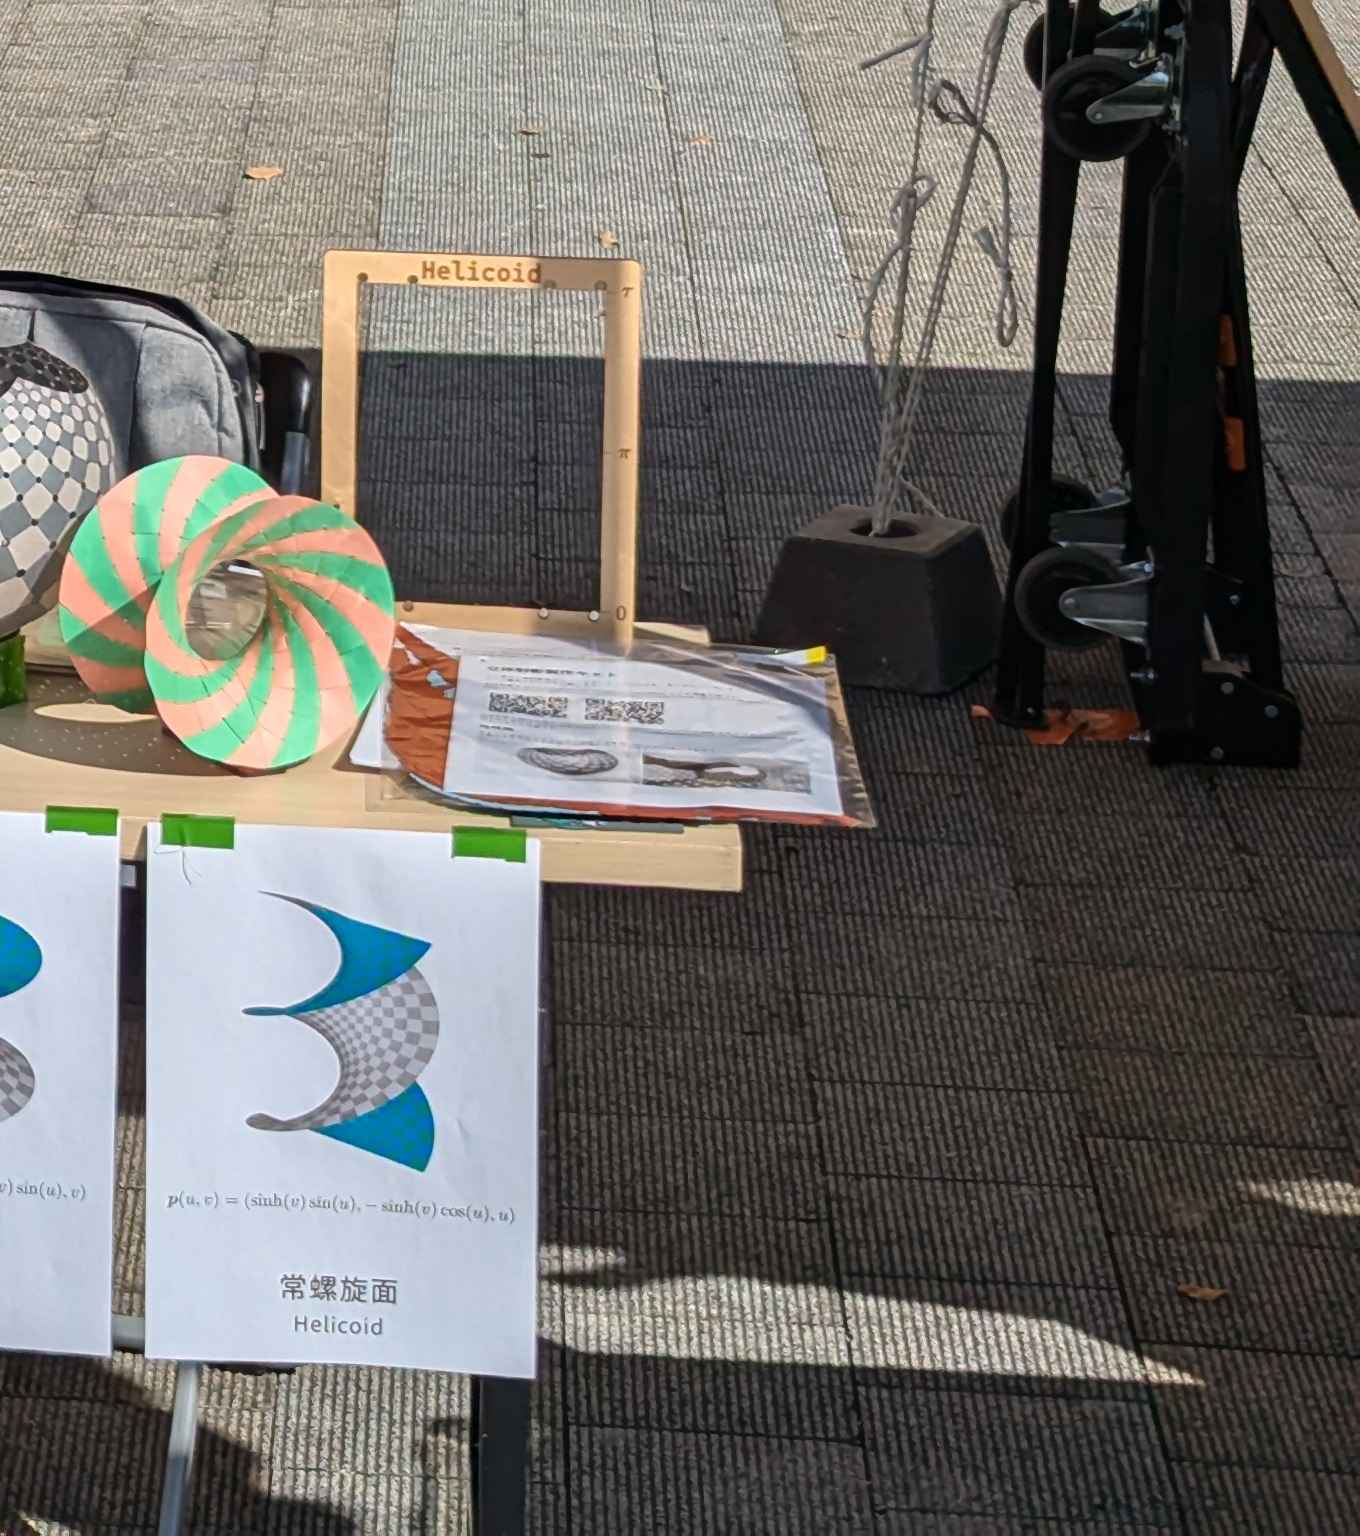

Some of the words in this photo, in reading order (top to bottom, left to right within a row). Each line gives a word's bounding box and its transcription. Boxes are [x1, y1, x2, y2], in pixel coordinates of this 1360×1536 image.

[421, 260, 543, 285] Helicoid
[280, 1273, 399, 1305] 常螺旋面
[293, 1315, 384, 1337] Helicoid
